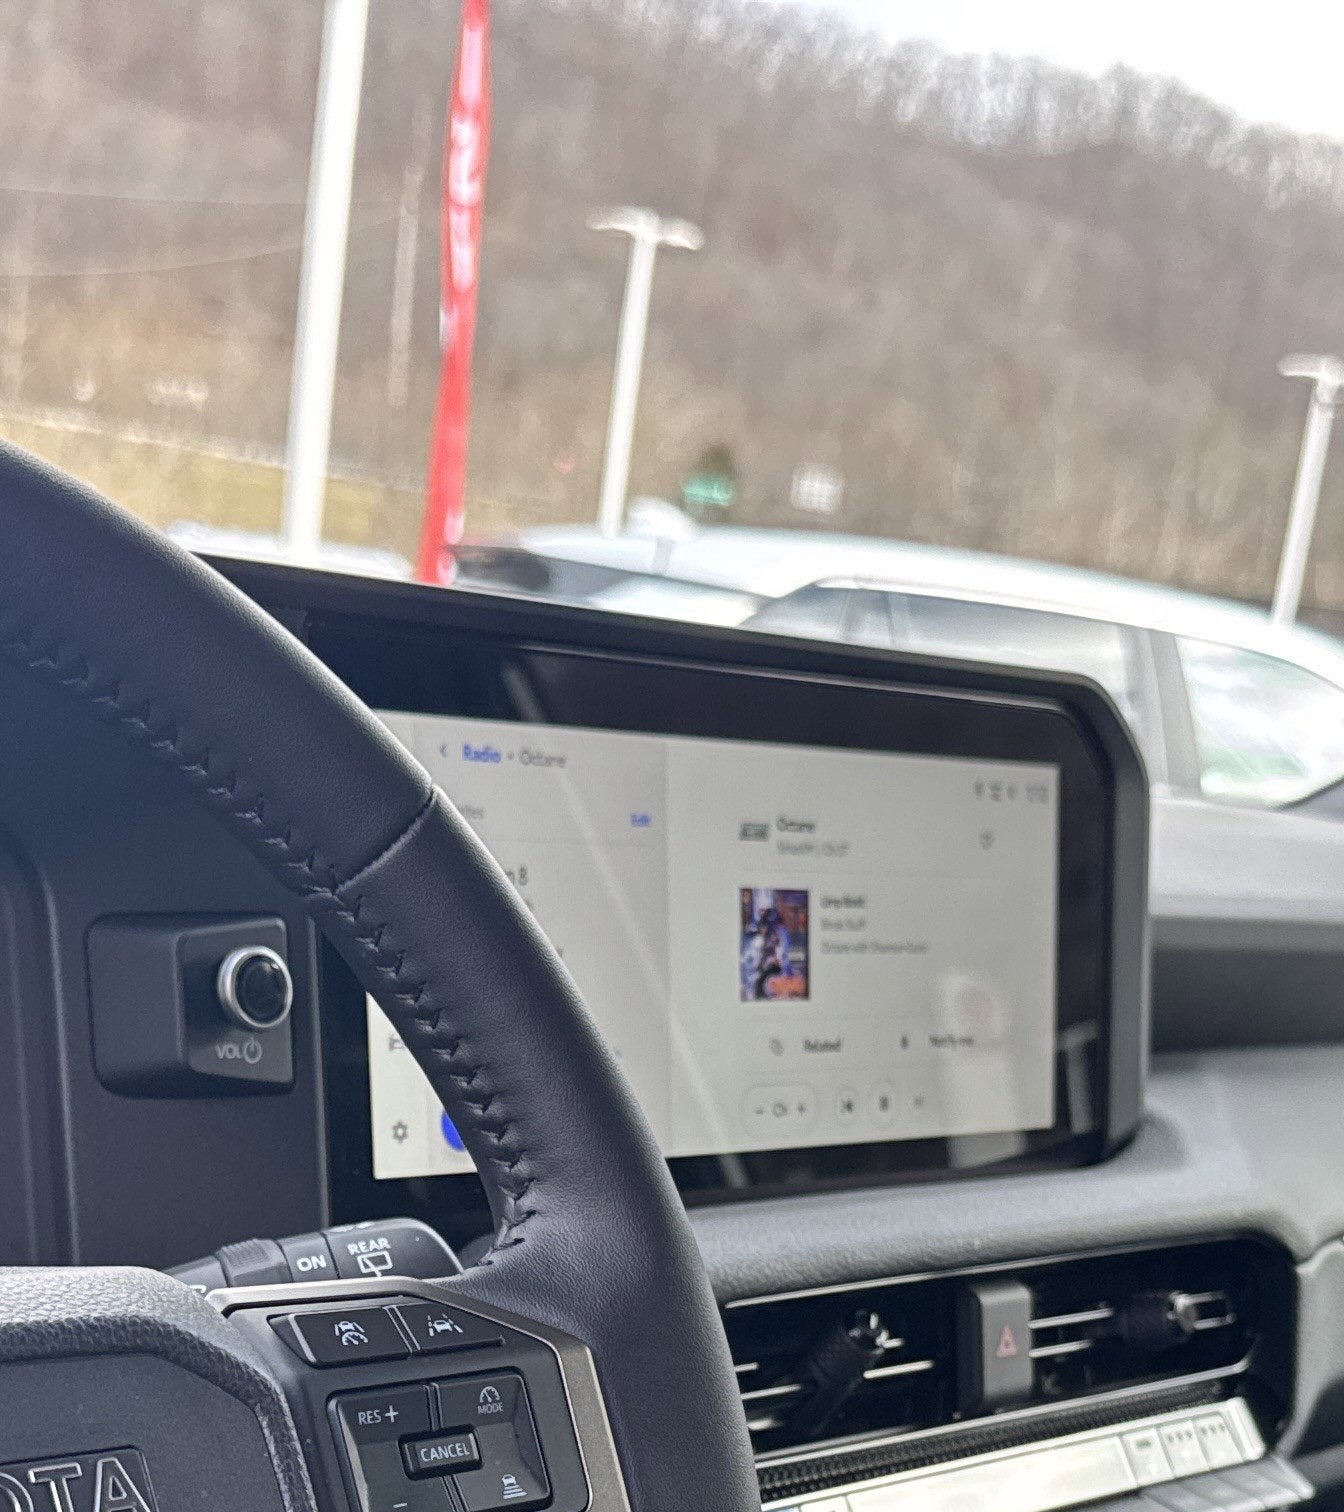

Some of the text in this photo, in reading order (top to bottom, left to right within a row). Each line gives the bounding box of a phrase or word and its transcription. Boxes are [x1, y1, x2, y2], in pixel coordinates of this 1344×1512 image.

[215, 1044, 243, 1060] VOL
[347, 1237, 392, 1256] REAR
[296, 1254, 327, 1273] ON
[477, 1401, 504, 1415] MODE
[420, 1442, 470, 1463] CANCEL
